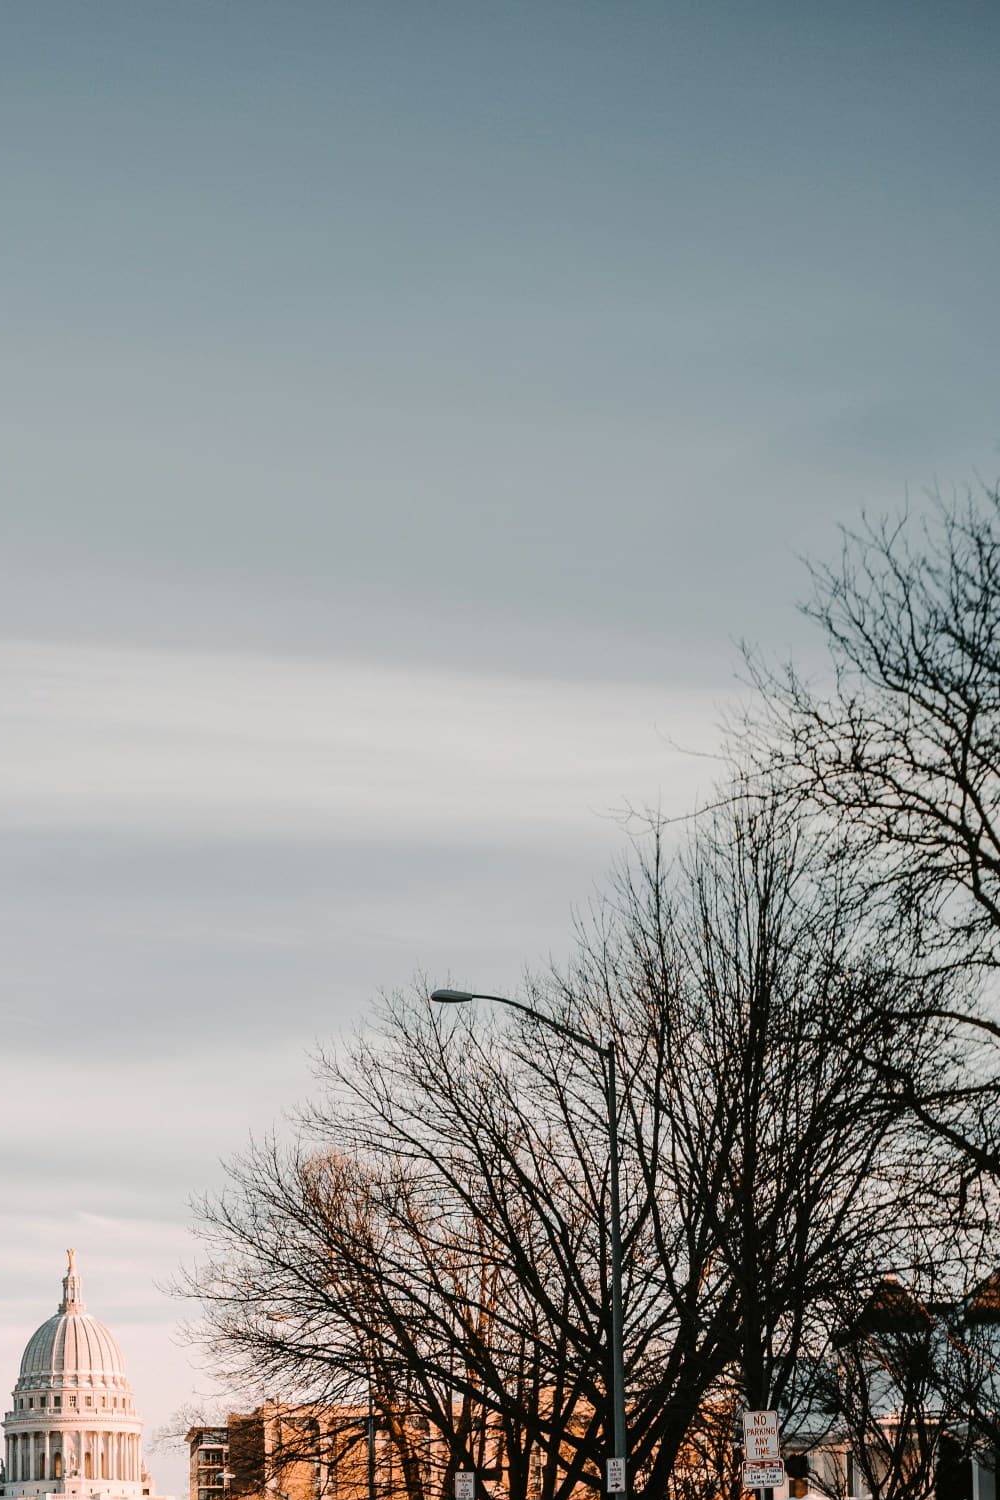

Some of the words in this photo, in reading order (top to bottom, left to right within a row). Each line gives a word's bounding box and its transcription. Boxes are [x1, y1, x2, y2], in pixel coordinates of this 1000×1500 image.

[753, 1415, 767, 1426] NO
[746, 1428, 776, 1436] PARKING
[754, 1438, 768, 1446] ANY
[754, 1447, 770, 1456] TIME
